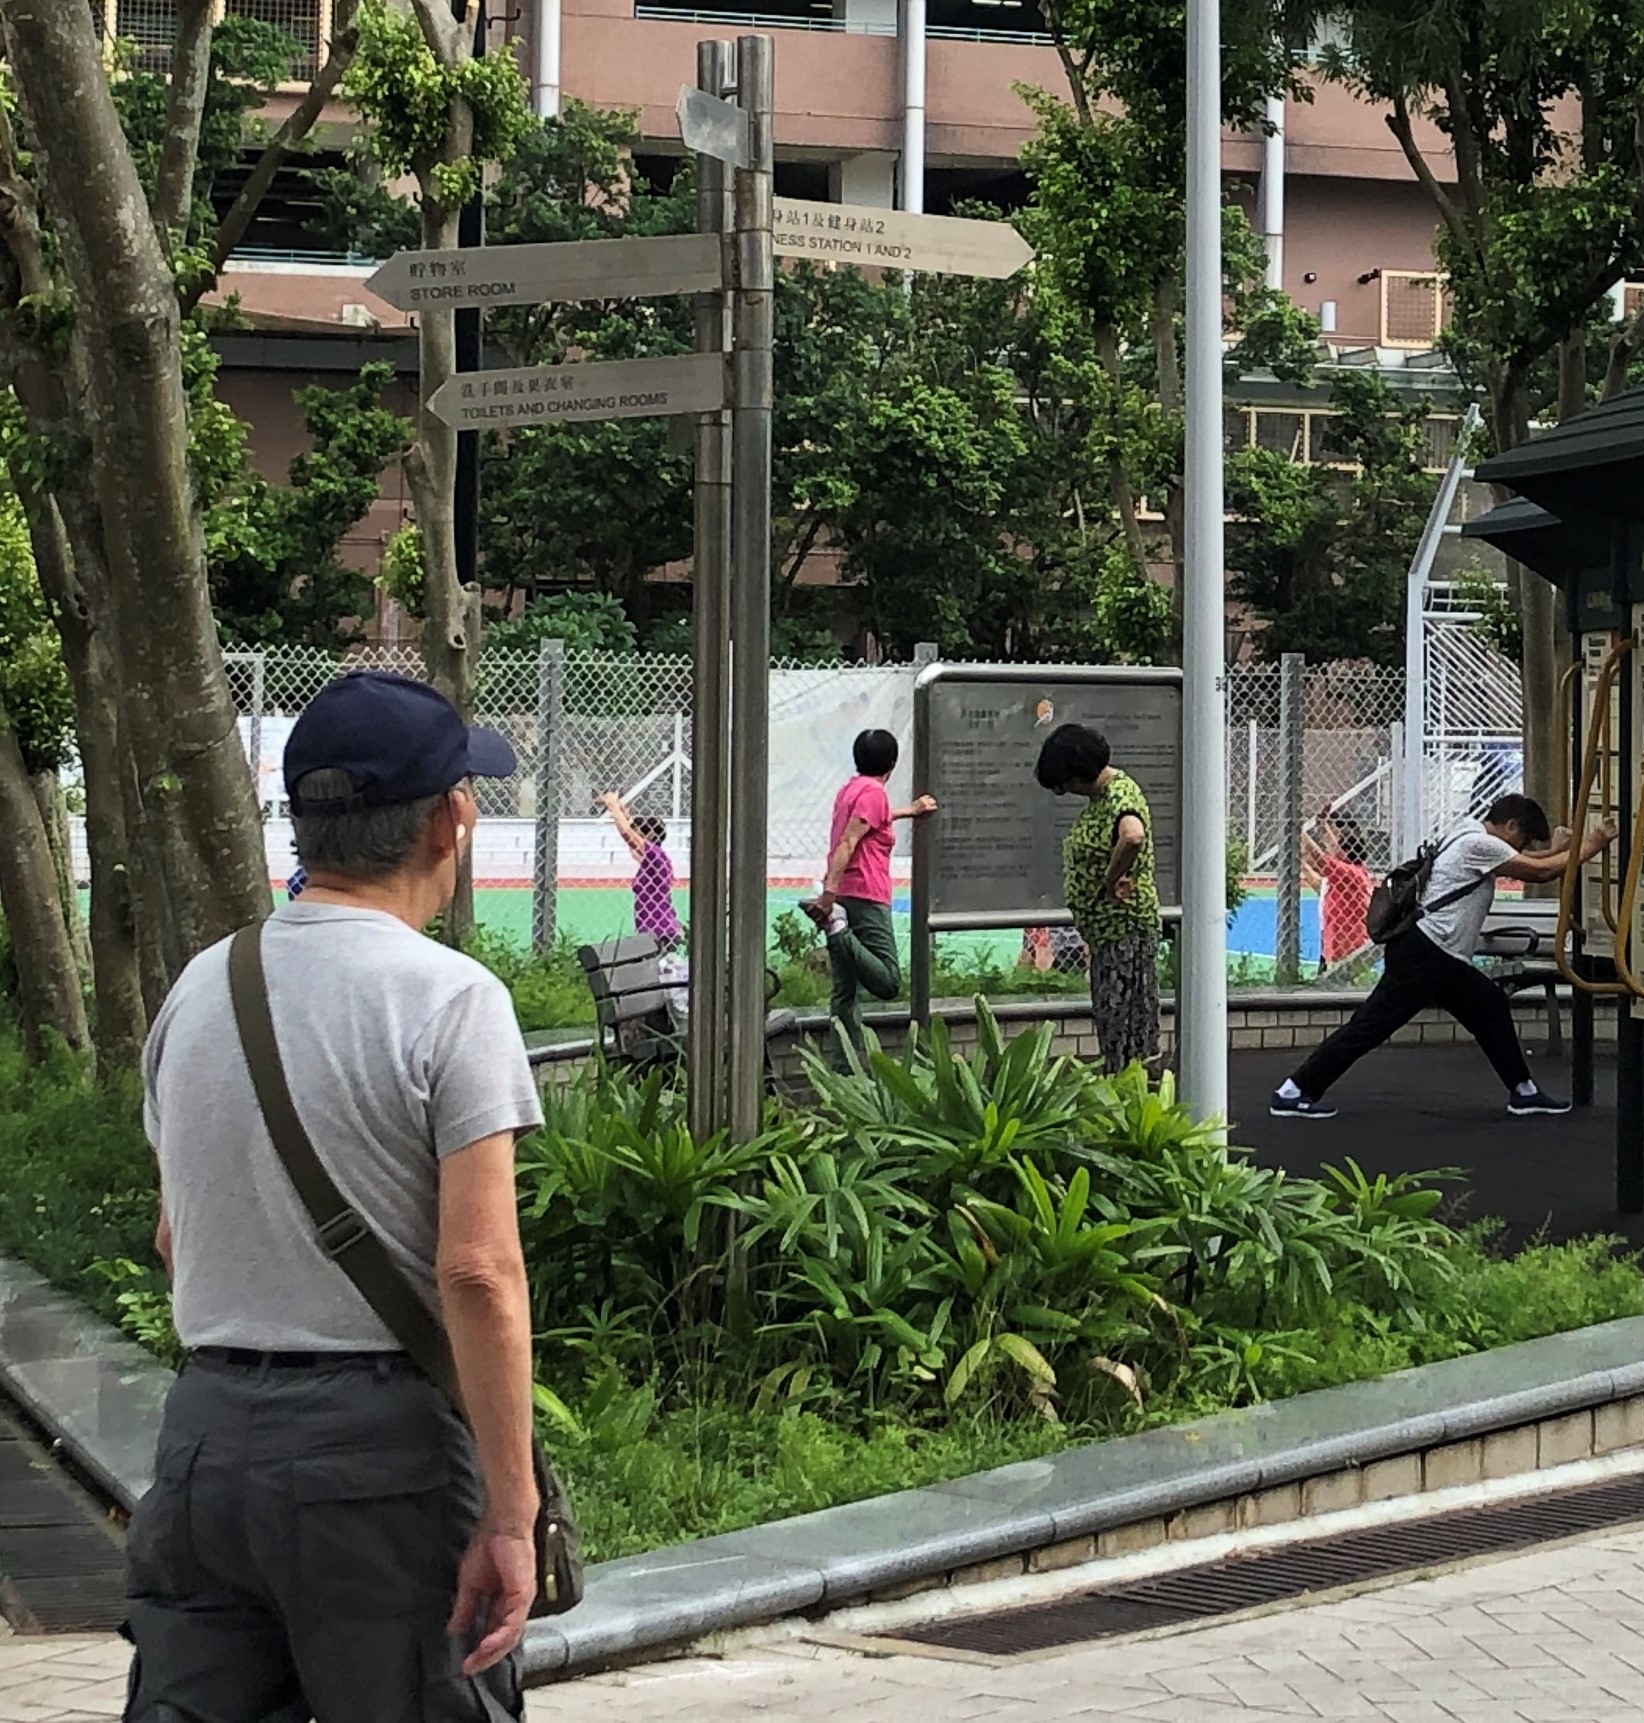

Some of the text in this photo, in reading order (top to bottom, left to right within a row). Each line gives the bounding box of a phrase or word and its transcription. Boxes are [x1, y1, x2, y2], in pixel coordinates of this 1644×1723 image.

[809, 236, 861, 253] STATION
[875, 244, 900, 258] AND
[904, 247, 912, 259] 2
[410, 282, 515, 300] STORE ROOM
[461, 392, 668, 419] TOILETS AND CHANGING ROOMS
